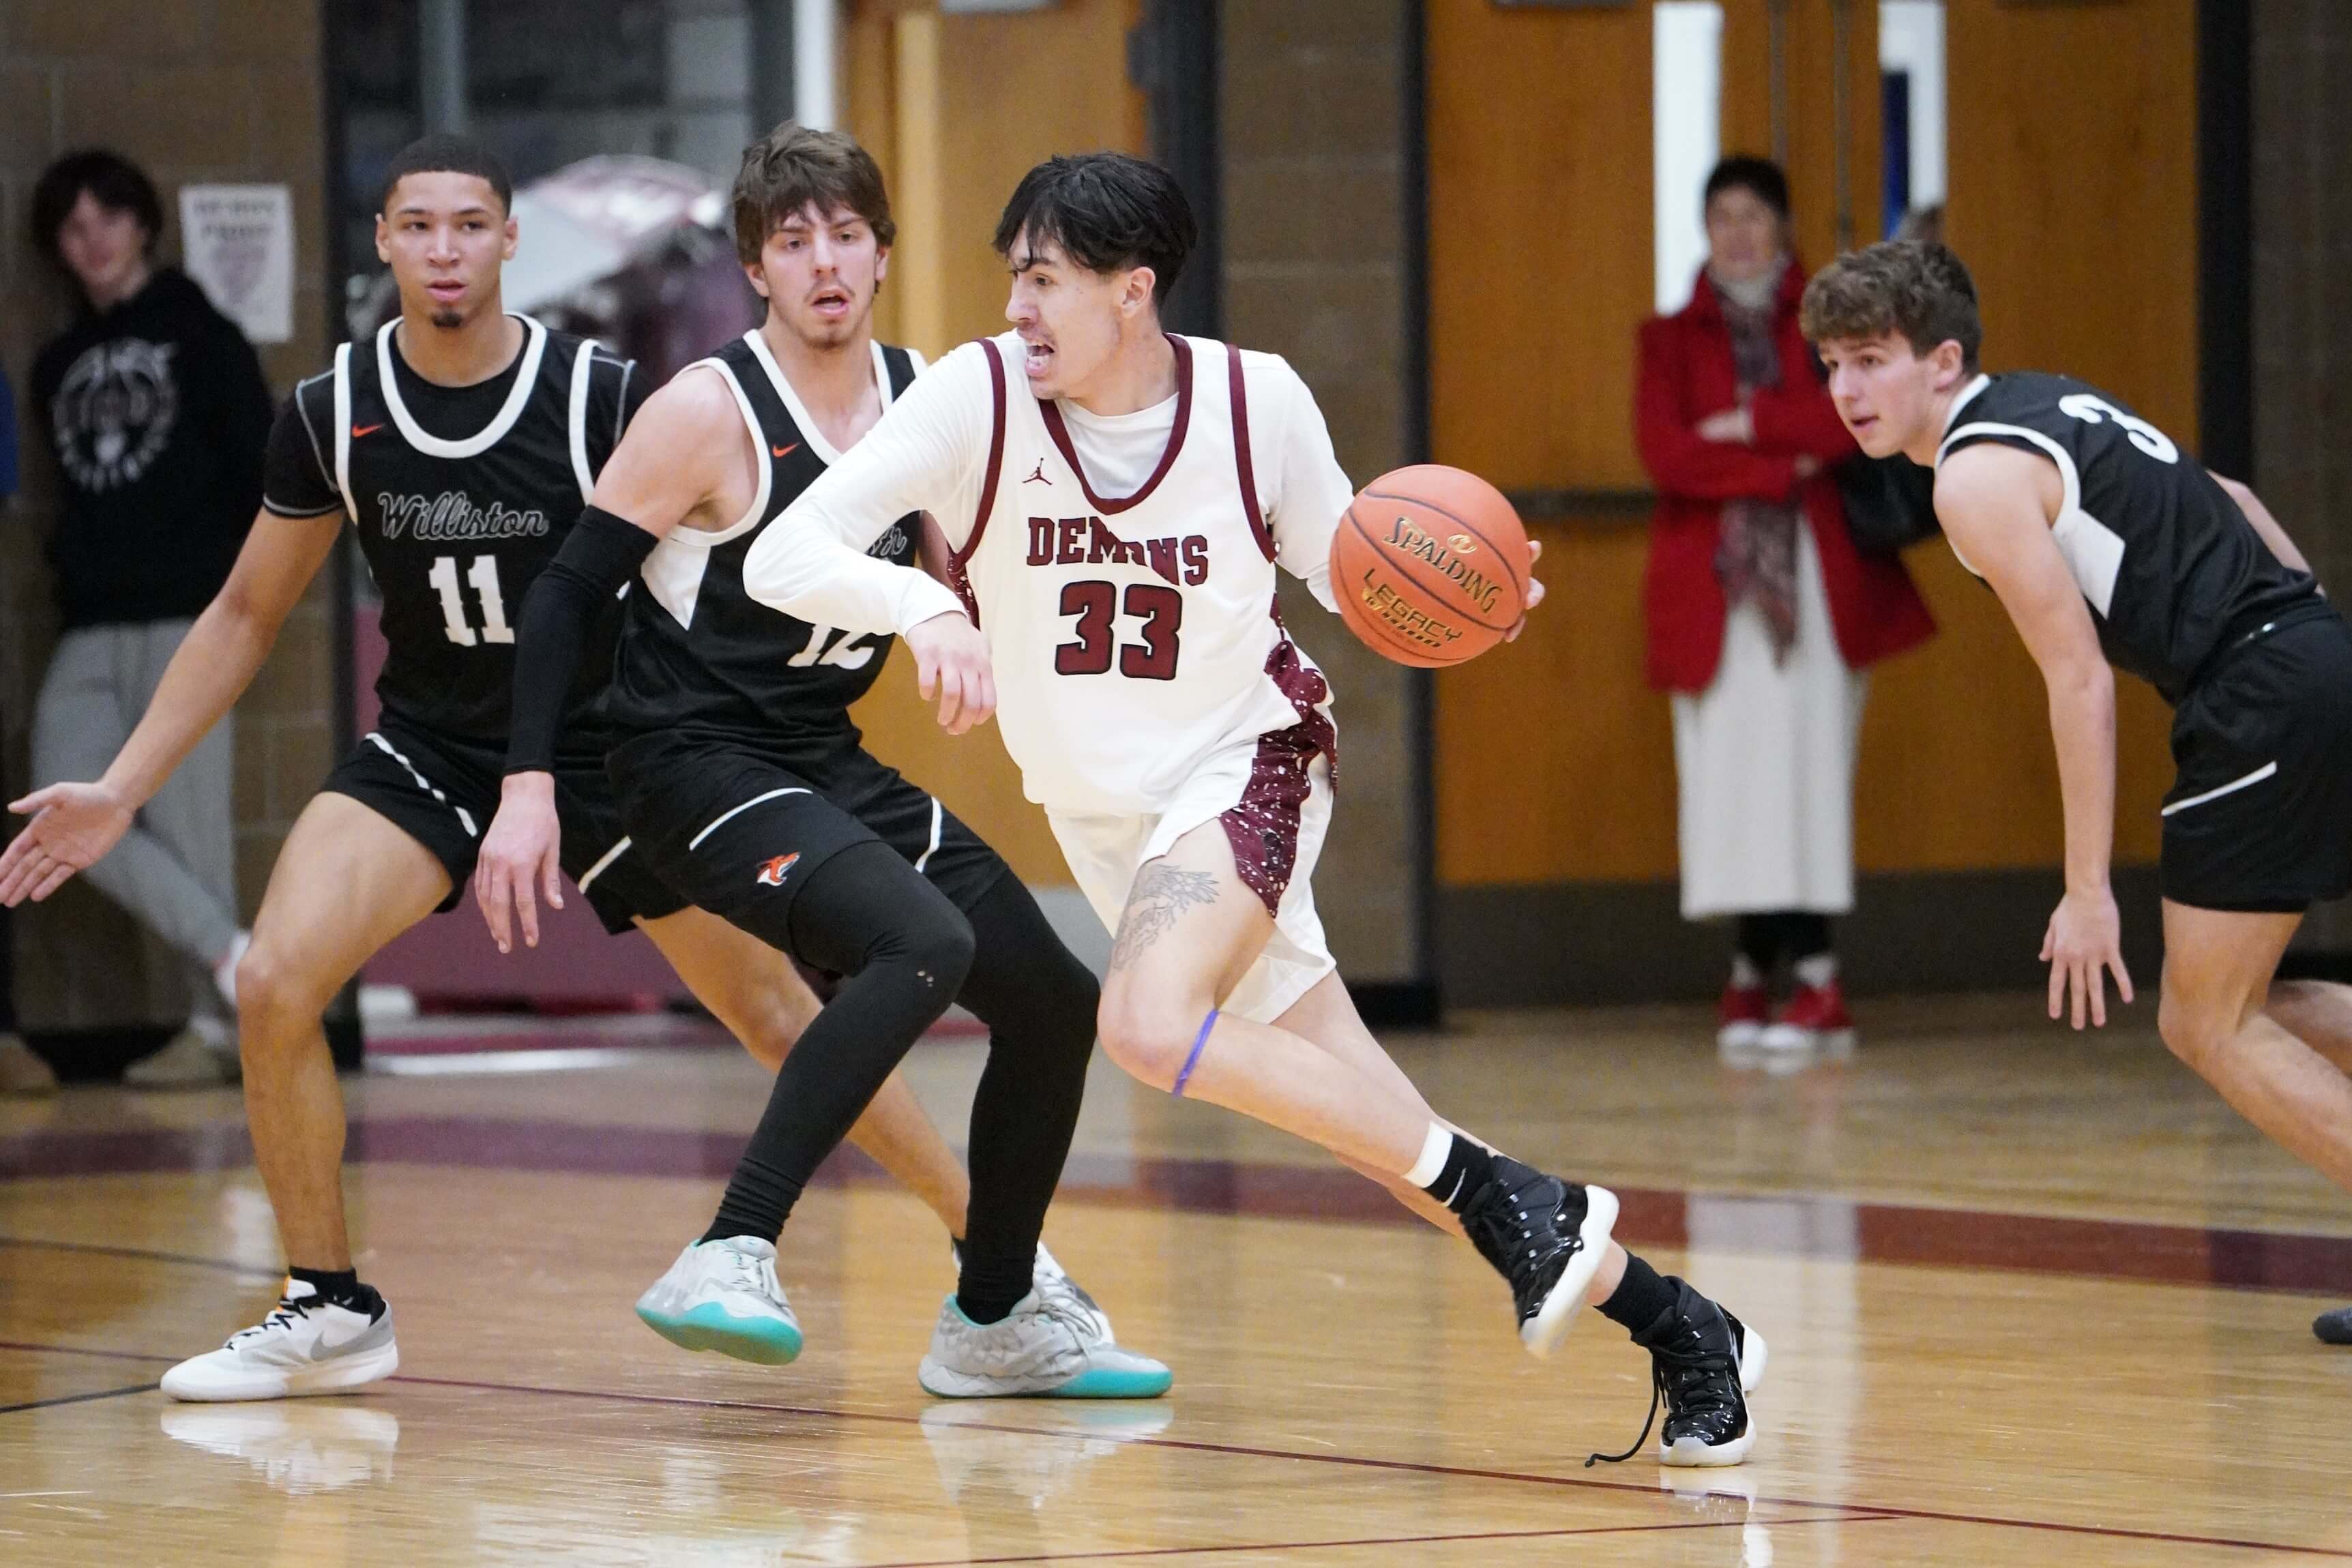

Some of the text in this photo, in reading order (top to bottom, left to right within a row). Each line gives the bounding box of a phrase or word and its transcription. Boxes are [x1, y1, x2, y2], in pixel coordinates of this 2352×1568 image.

[2059, 394, 2179, 464] 3
[377, 490, 550, 540] Williston
[428, 554, 515, 647] 11
[1364, 567, 1463, 642] LEGACY
[1383, 516, 1503, 614] SPALDING
[1055, 580, 1183, 681] 33
